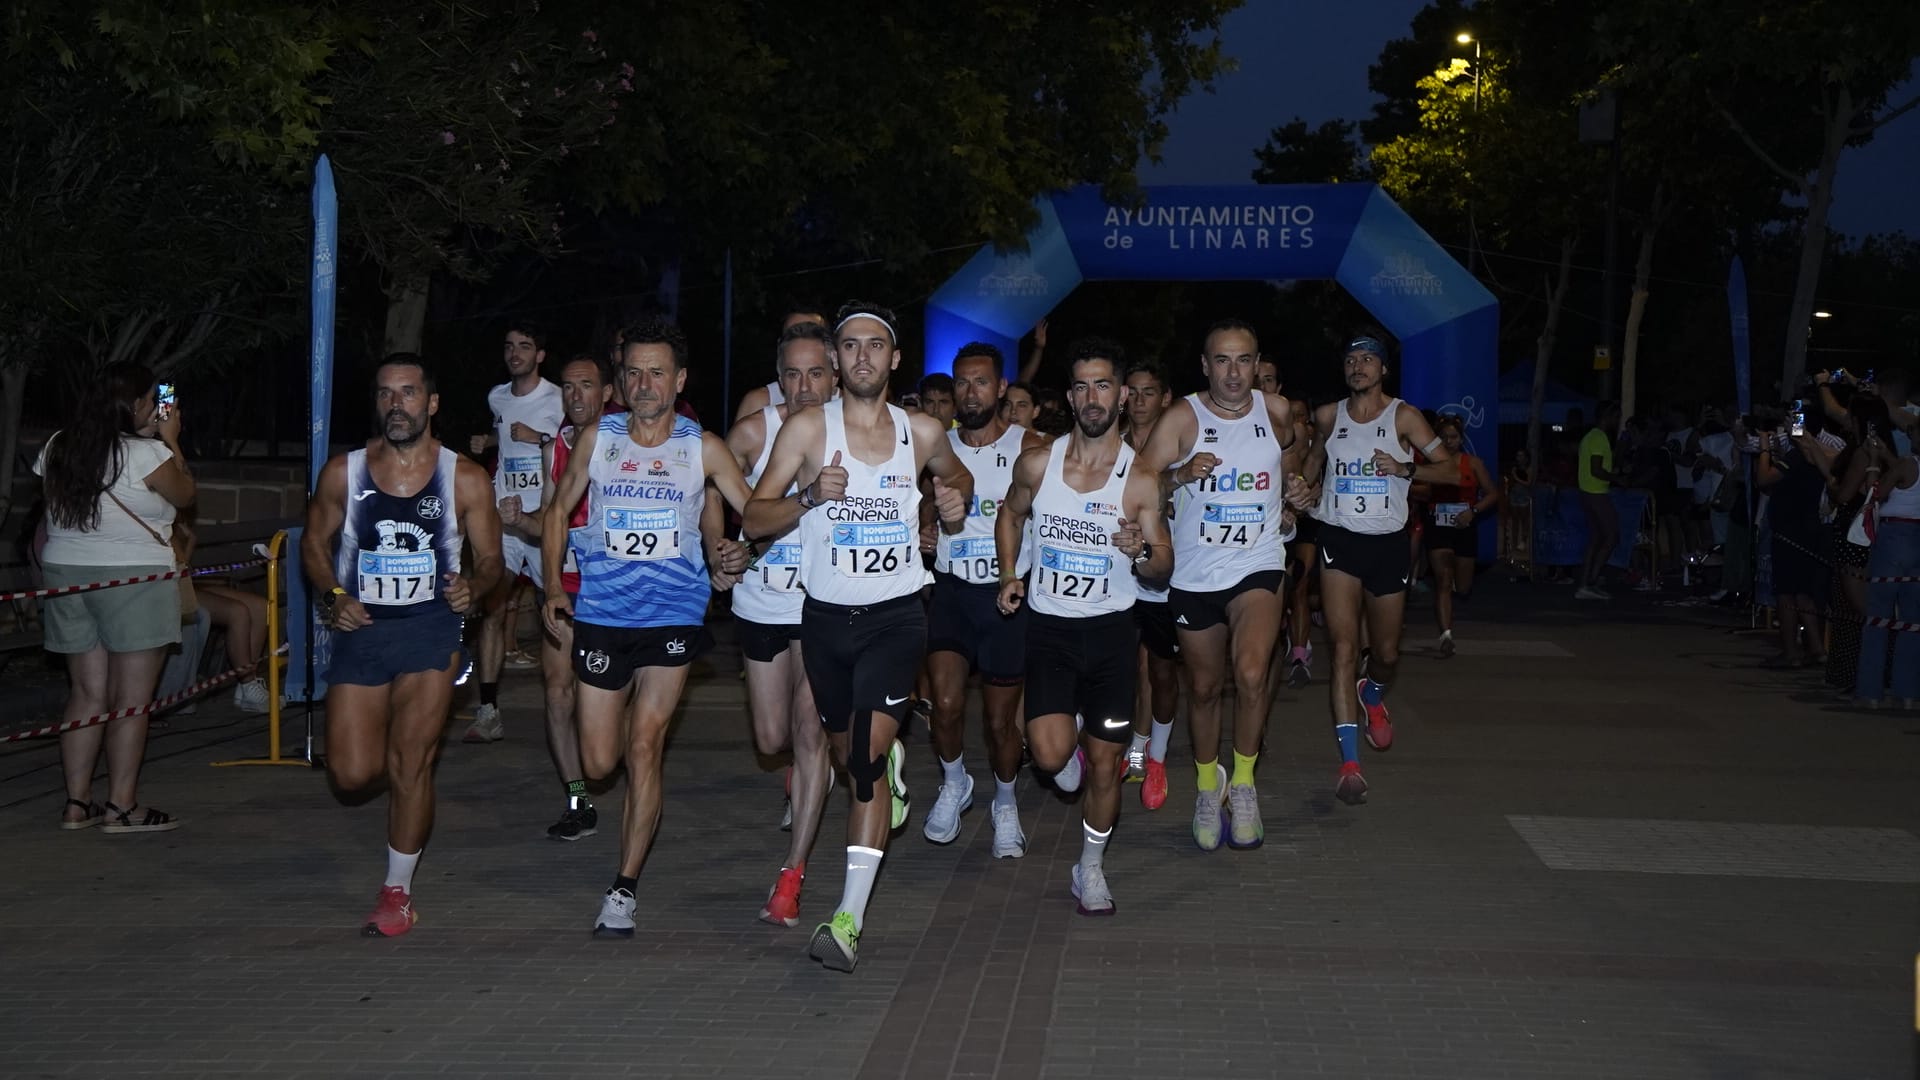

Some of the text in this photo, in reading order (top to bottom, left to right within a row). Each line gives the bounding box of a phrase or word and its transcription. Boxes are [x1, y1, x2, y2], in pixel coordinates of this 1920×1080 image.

[1104, 205, 1314, 226] AYUNTAMIENTO
[1104, 227, 1314, 249] de LINARES
[512, 472, 540, 489] 134
[603, 484, 684, 502] MARACENA
[1354, 496, 1366, 513] 3
[1444, 513, 1456, 525] 15
[625, 532, 658, 555] 29
[1220, 525, 1247, 545] 74
[849, 547, 898, 573] 126
[962, 558, 1000, 580] 105
[375, 577, 421, 599] 117
[1052, 571, 1095, 598] 127
